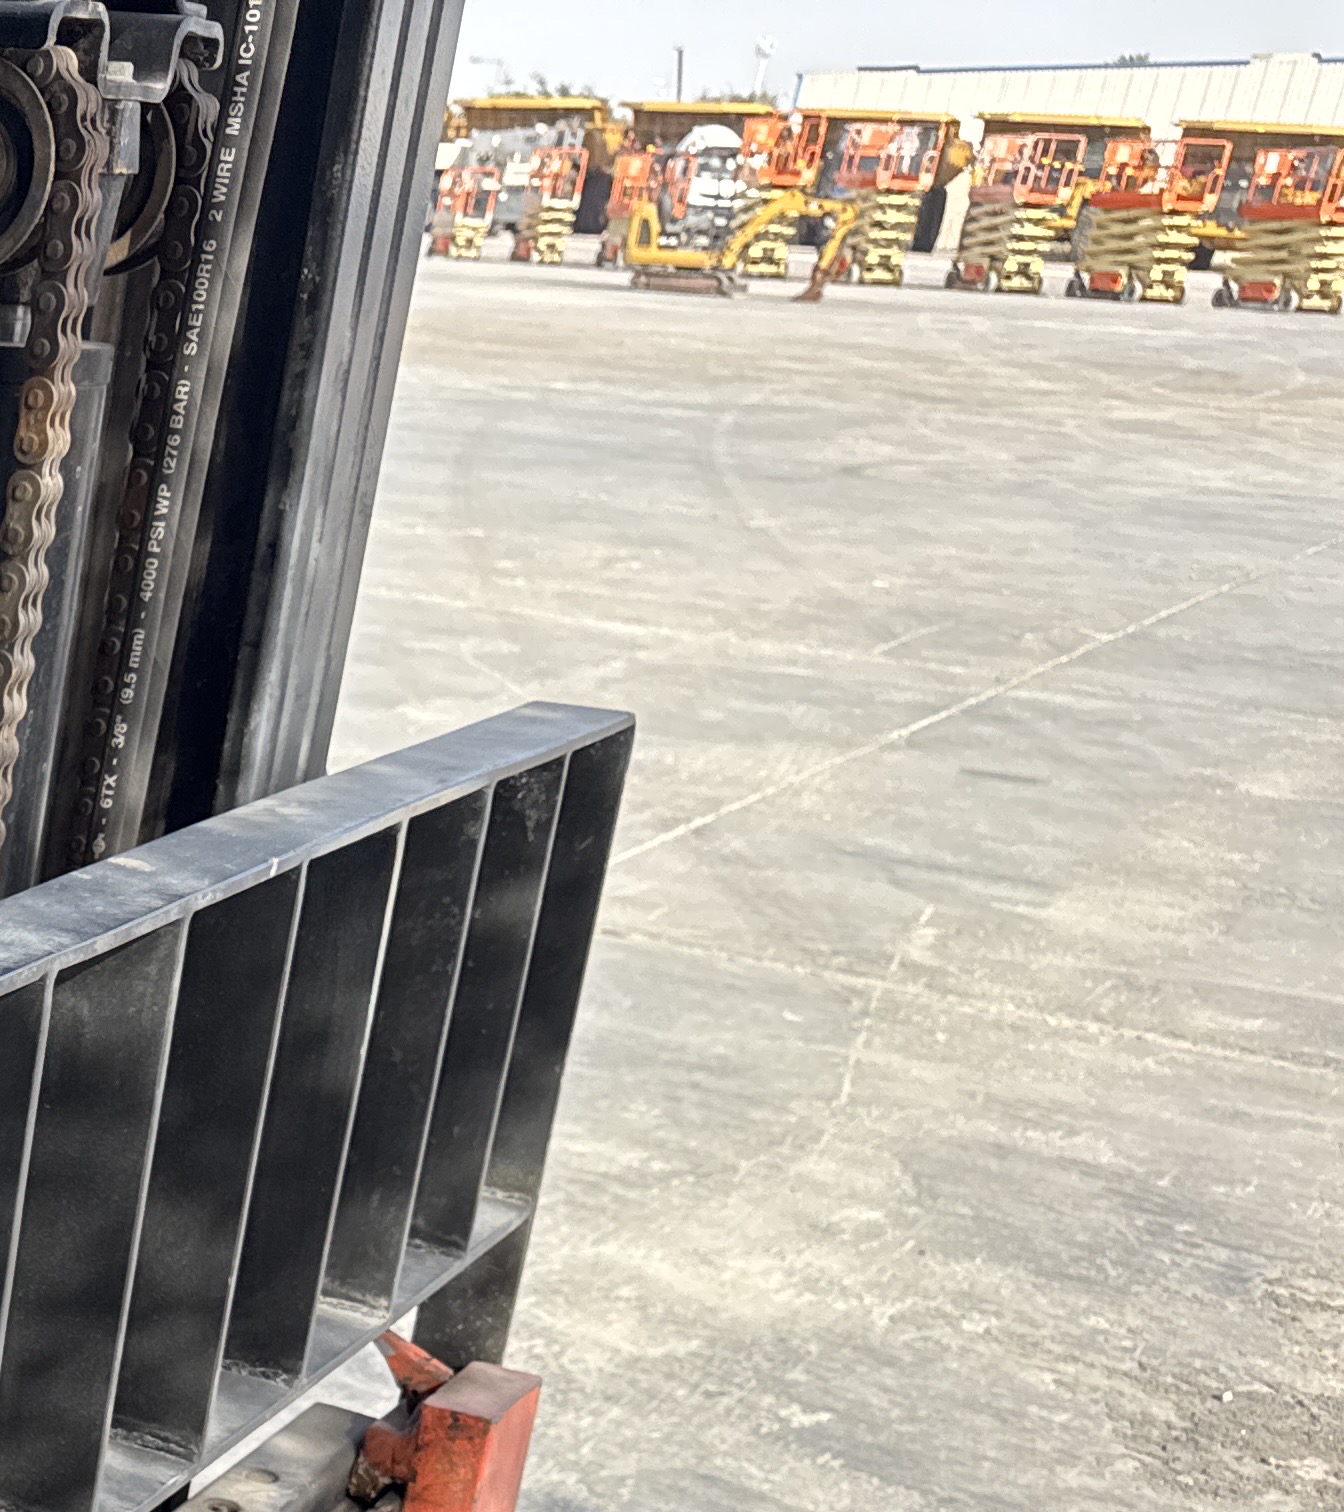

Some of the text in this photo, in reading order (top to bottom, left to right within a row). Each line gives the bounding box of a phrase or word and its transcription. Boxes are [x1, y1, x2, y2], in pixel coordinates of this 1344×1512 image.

[225, 70, 250, 136] MSHA
[212, 147, 236, 203] WIRE
[208, 209, 223, 223] 2
[183, 239, 217, 357] SAE100R16
[170, 379, 191, 429] BAR)
[163, 434, 181, 474] (276
[153, 483, 172, 516] WP
[147, 521, 166, 553] PSI
[139, 557, 160, 602] 4000
[128, 628, 146, 669] mm)
[119, 672, 138, 705] (9.5
[99, 774, 118, 809] 6TX
